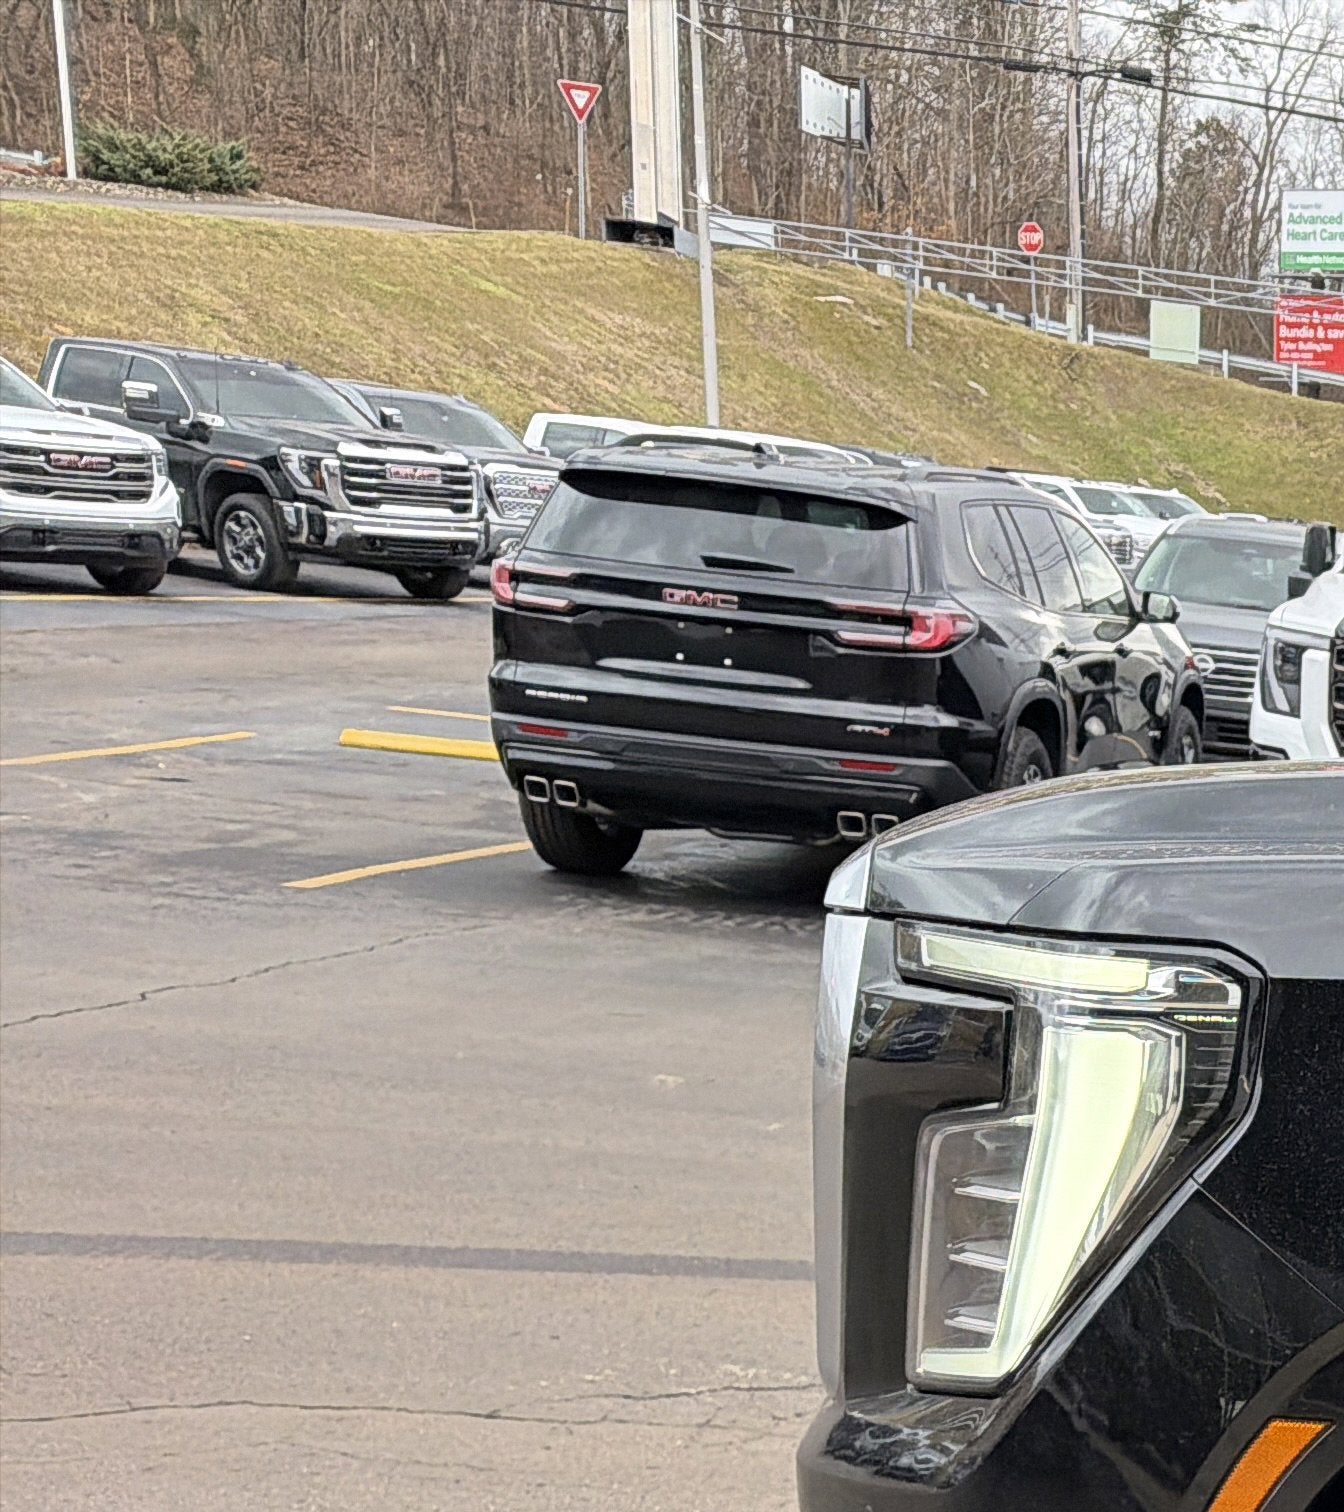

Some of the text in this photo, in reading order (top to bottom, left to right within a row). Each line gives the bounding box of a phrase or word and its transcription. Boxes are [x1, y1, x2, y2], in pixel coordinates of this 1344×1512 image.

[1287, 212, 1343, 225] Advanced
[1020, 231, 1041, 245] STOP
[1287, 229, 1317, 241] Heart
[1279, 325, 1314, 338] Bundle
[1316, 325, 1325, 338] &
[662, 588, 739, 610] GMC
